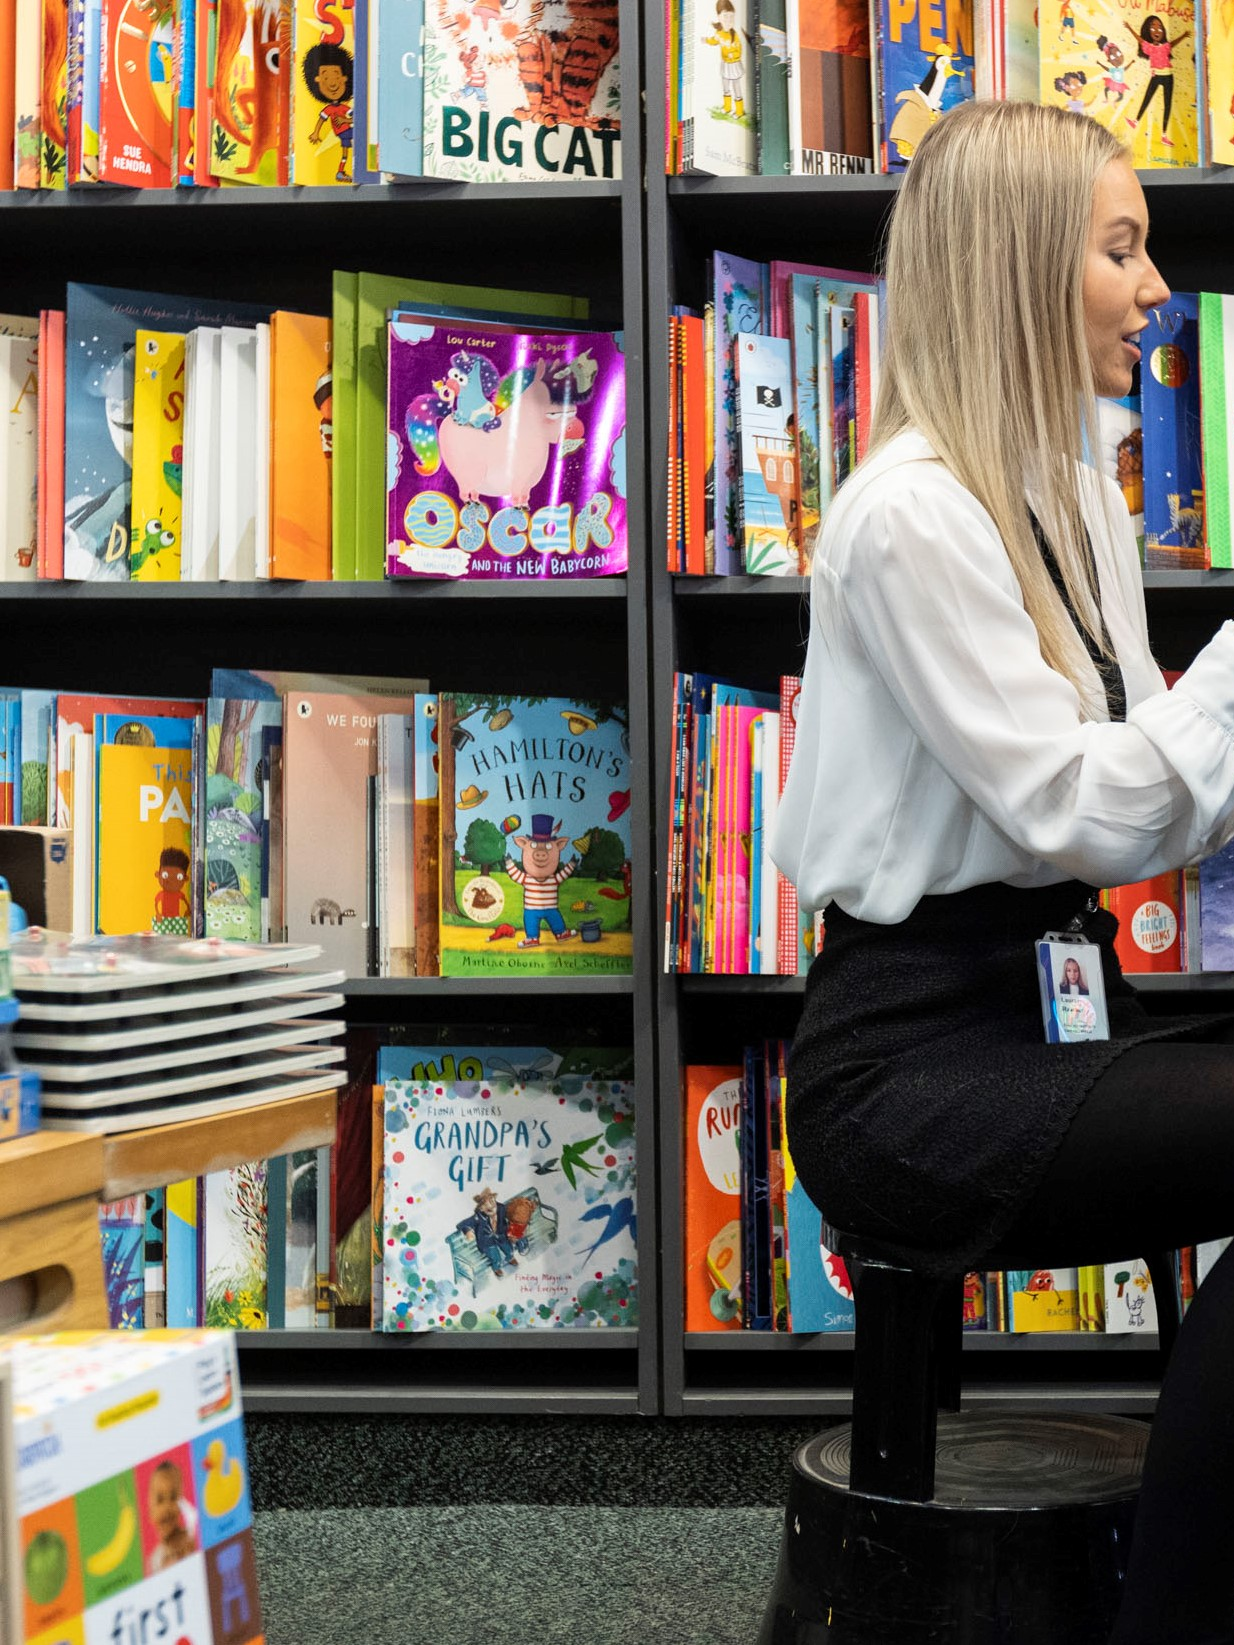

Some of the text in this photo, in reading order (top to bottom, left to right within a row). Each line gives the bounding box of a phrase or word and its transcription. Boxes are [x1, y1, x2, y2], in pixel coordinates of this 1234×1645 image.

[442, 105, 621, 178] BIG CAT
[123, 145, 142, 158] SUE
[112, 156, 151, 175] HENDRA
[801, 149, 824, 175] MR
[466, 336, 497, 349] Carter
[471, 560, 491, 572] AND
[493, 560, 512, 573] THE
[516, 560, 547, 575] NEW
[326, 714, 347, 727] WE
[354, 737, 370, 747] JON
[471, 738, 624, 778] HAMILTON'S
[503, 770, 586, 804] HATS
[1145, 903, 1160, 918] BIG
[1140, 916, 1167, 932] BRIGHT
[1141, 929, 1170, 945] FEELINGS
[461, 955, 504, 968] Martine
[427, 1106, 455, 1117] FIONA
[414, 1119, 552, 1154] GRANDPA'S
[448, 1154, 512, 1193] GIFT
